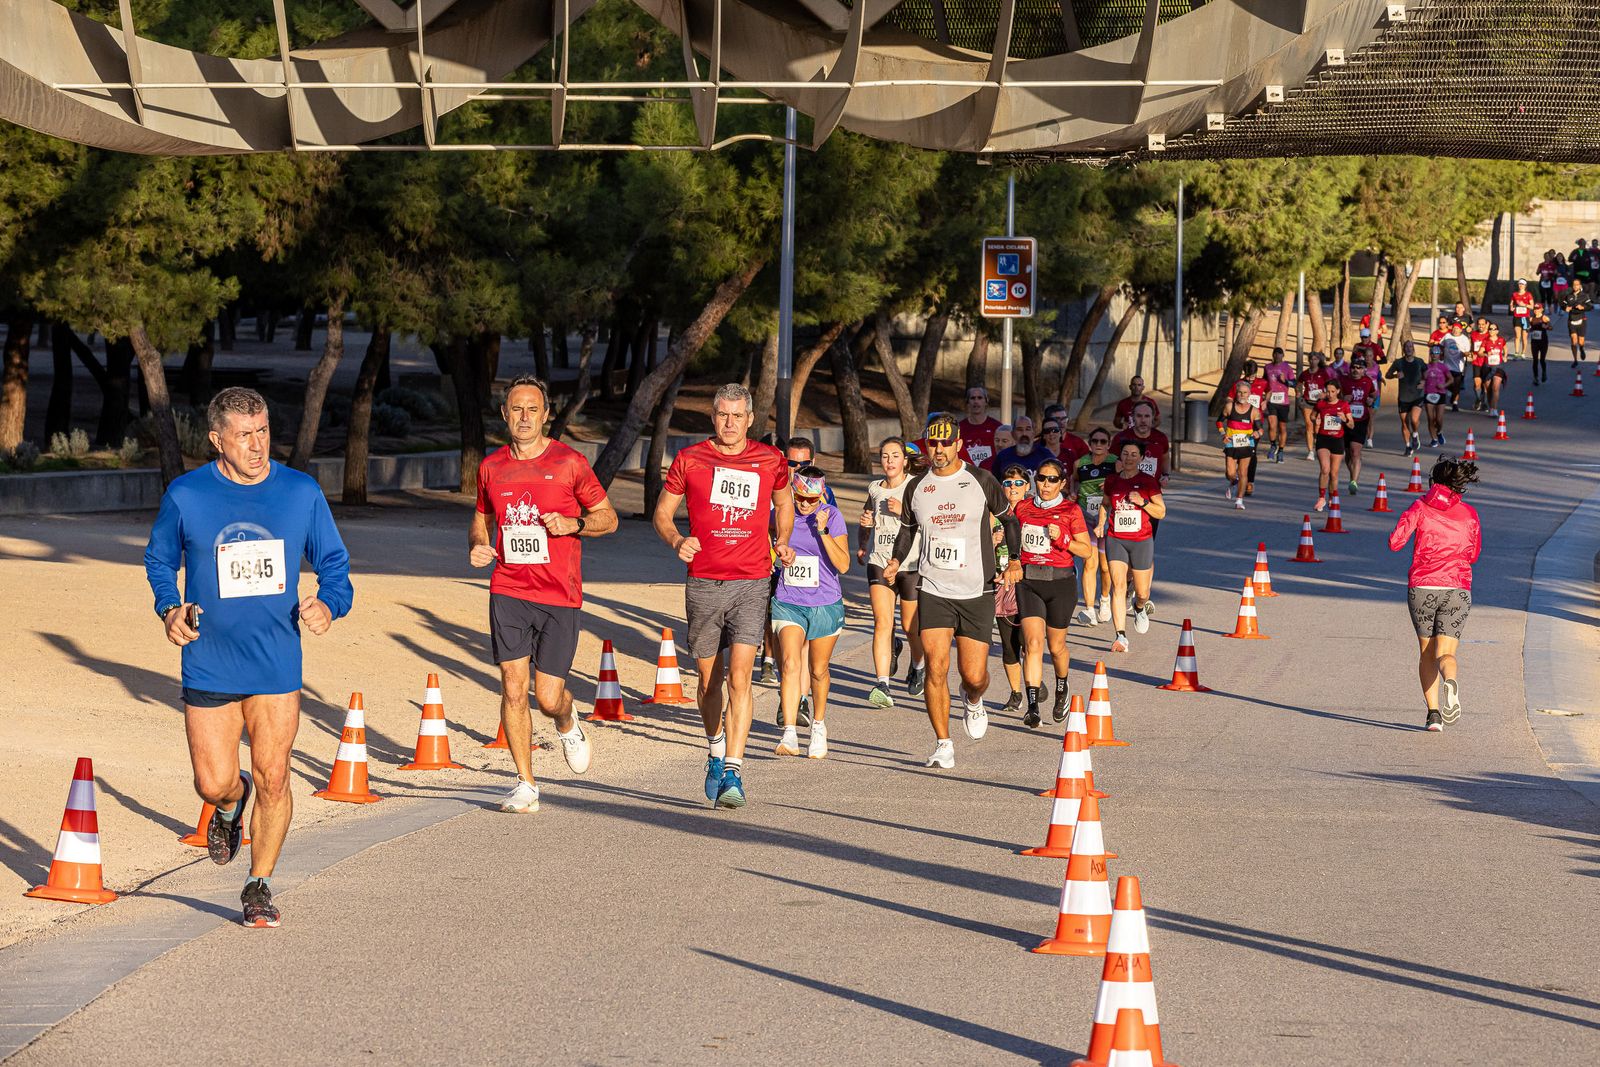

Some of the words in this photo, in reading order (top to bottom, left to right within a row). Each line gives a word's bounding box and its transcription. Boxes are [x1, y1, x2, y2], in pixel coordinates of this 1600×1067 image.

[1014, 286, 1024, 295] 10
[720, 480, 751, 498] 0616
[923, 484, 936, 493] edp
[937, 501, 956, 511] edp
[1118, 517, 1137, 526] 0804
[510, 538, 540, 553] 0350
[878, 534, 896, 545] 0765
[1025, 533, 1045, 546] 0912
[935, 547, 958, 561] 0471
[788, 565, 812, 578] 0221
